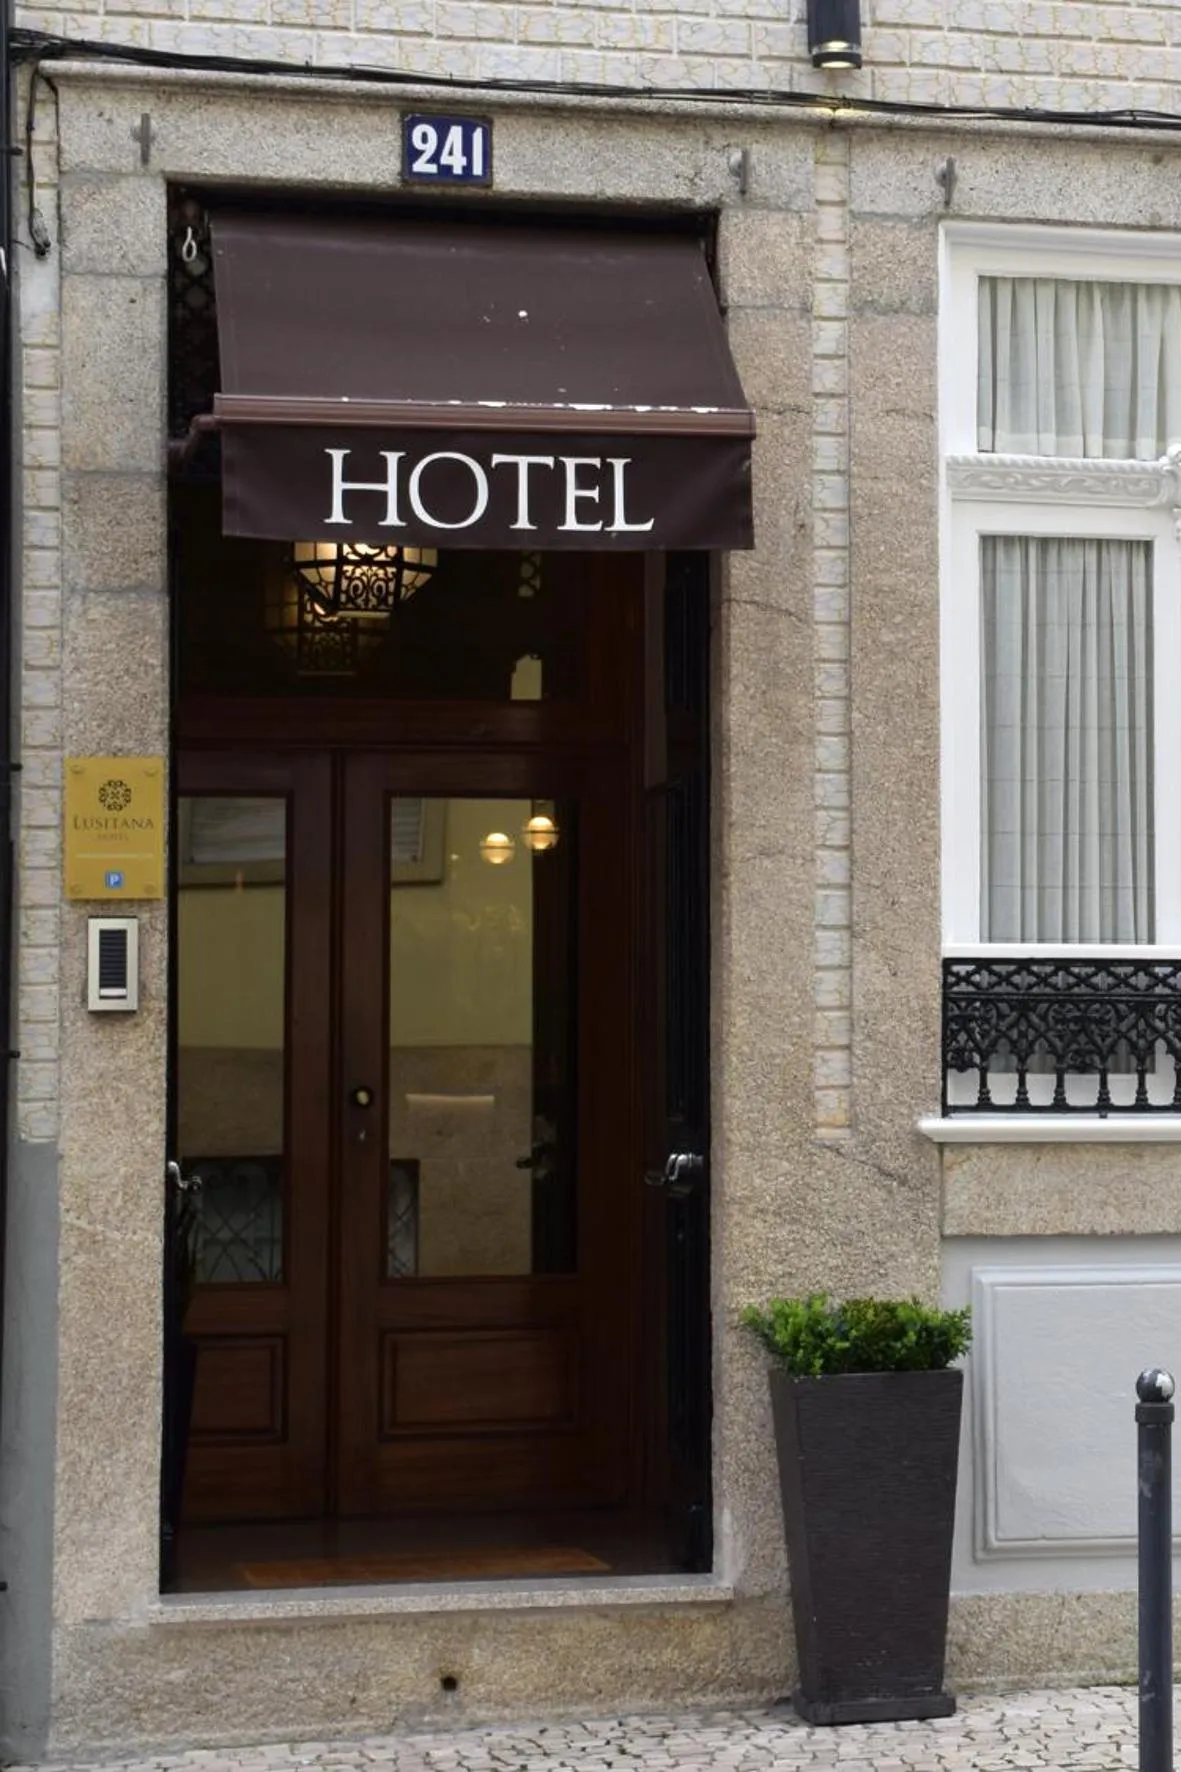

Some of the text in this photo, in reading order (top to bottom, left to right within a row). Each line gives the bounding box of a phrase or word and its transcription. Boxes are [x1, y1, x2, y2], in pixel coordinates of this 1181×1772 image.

[411, 124, 485, 177] 241
[323, 447, 655, 533] HOTEL
[73, 814, 154, 831] LUSITANA
